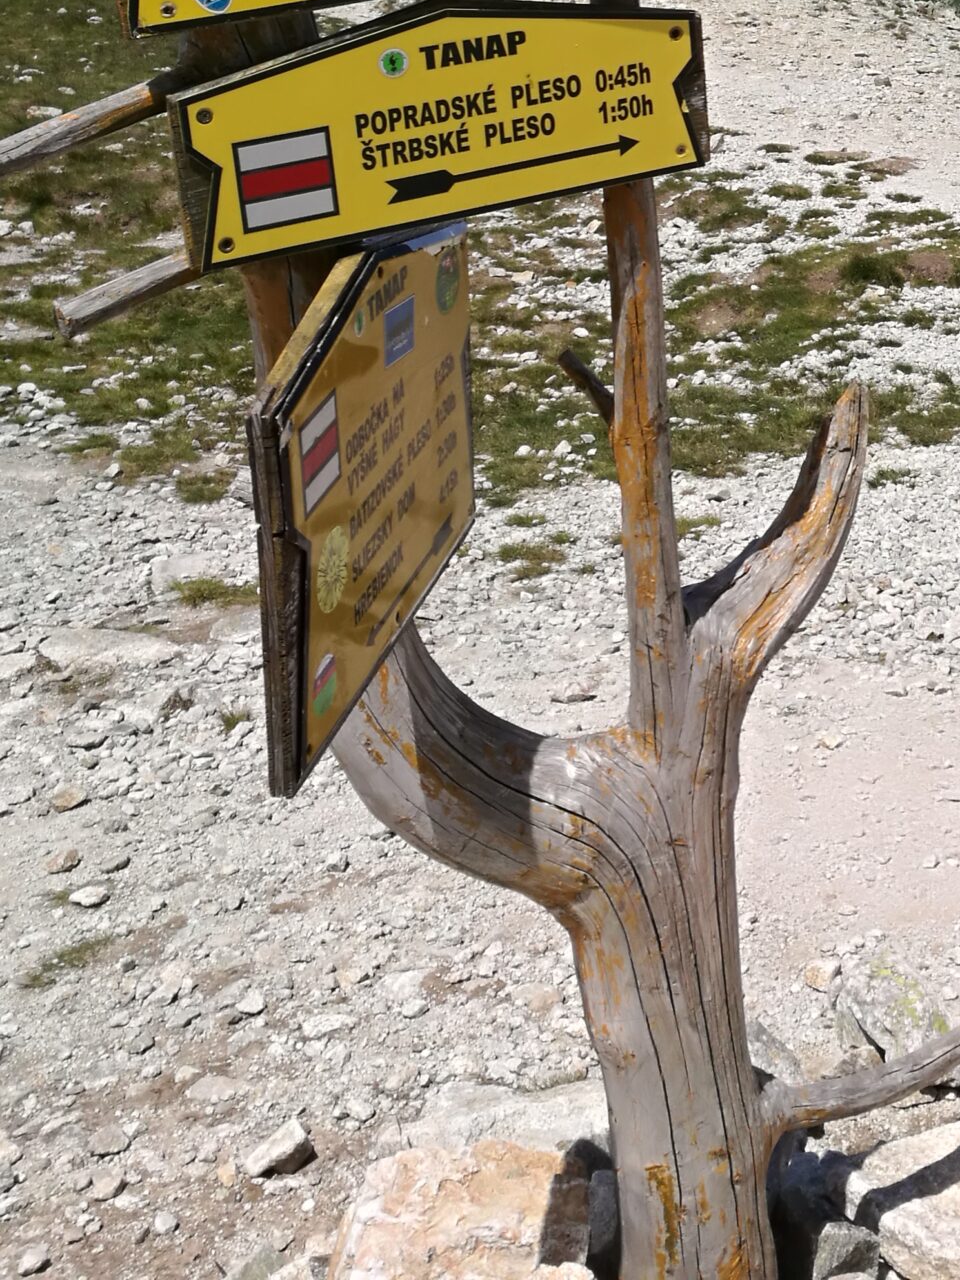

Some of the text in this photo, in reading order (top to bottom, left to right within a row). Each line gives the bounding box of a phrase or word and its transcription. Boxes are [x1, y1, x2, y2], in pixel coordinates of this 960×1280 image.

[419, 31, 526, 70] TANAP
[355, 62, 652, 138] POPRADSKÉ PLESO 0:45h
[361, 95, 654, 170] ŠTRBSKÉ PLESO 1:50h
[367, 266, 408, 322] TANAP
[345, 397, 389, 464] ODBOČKA
[347, 438, 378, 496] VYŠNÉ
[350, 448, 404, 540] BATIZOVSKÉ
[407, 418, 432, 466] PLESO
[354, 541, 404, 625] HREBIENOK
